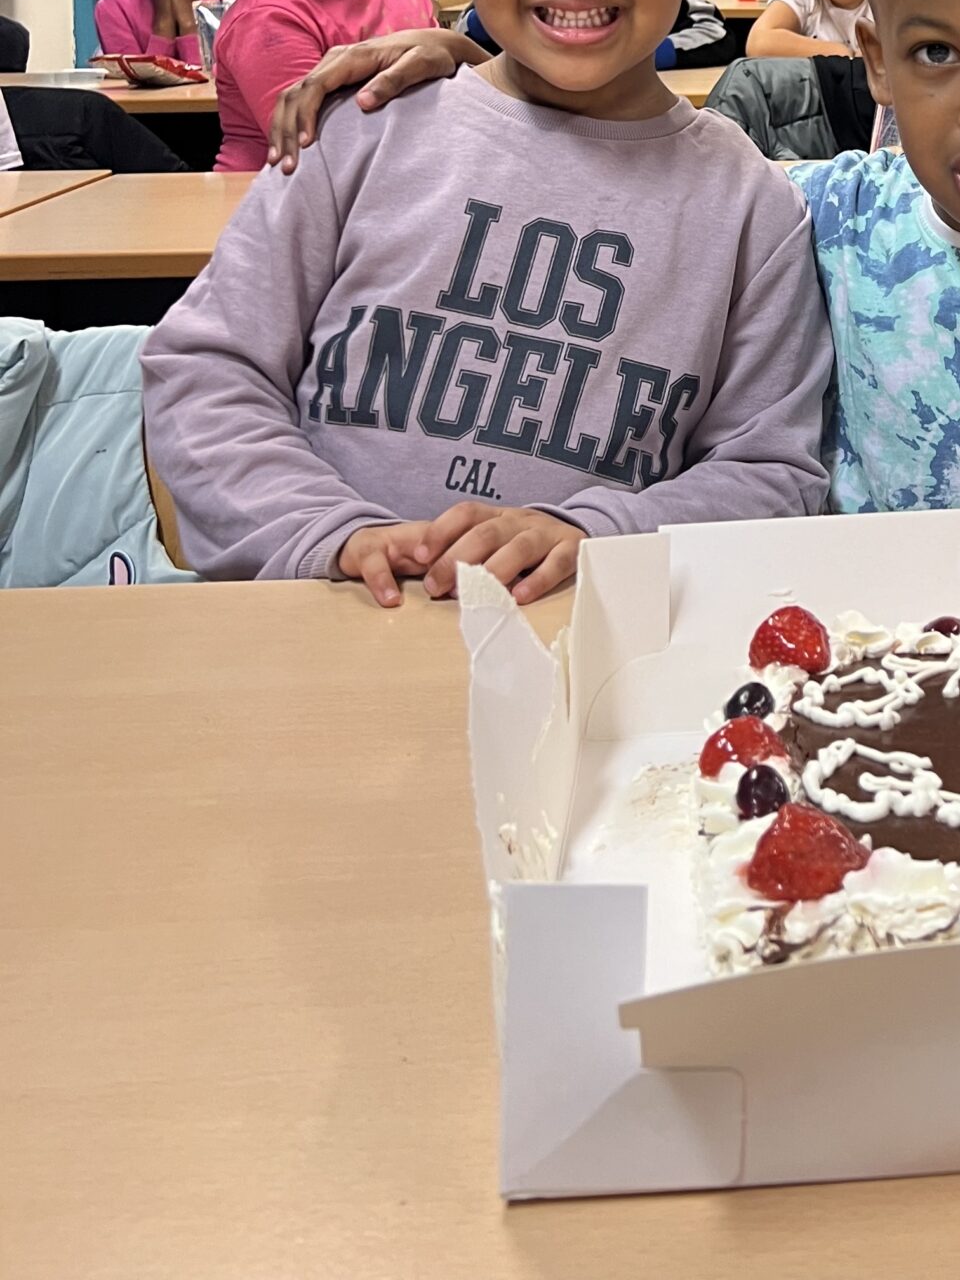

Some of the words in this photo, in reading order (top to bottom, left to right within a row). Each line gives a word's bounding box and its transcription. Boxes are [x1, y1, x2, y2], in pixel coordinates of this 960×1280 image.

[437, 198, 634, 342] LOS
[309, 305, 700, 489] ANGELES
[445, 455, 502, 500] CAL.
